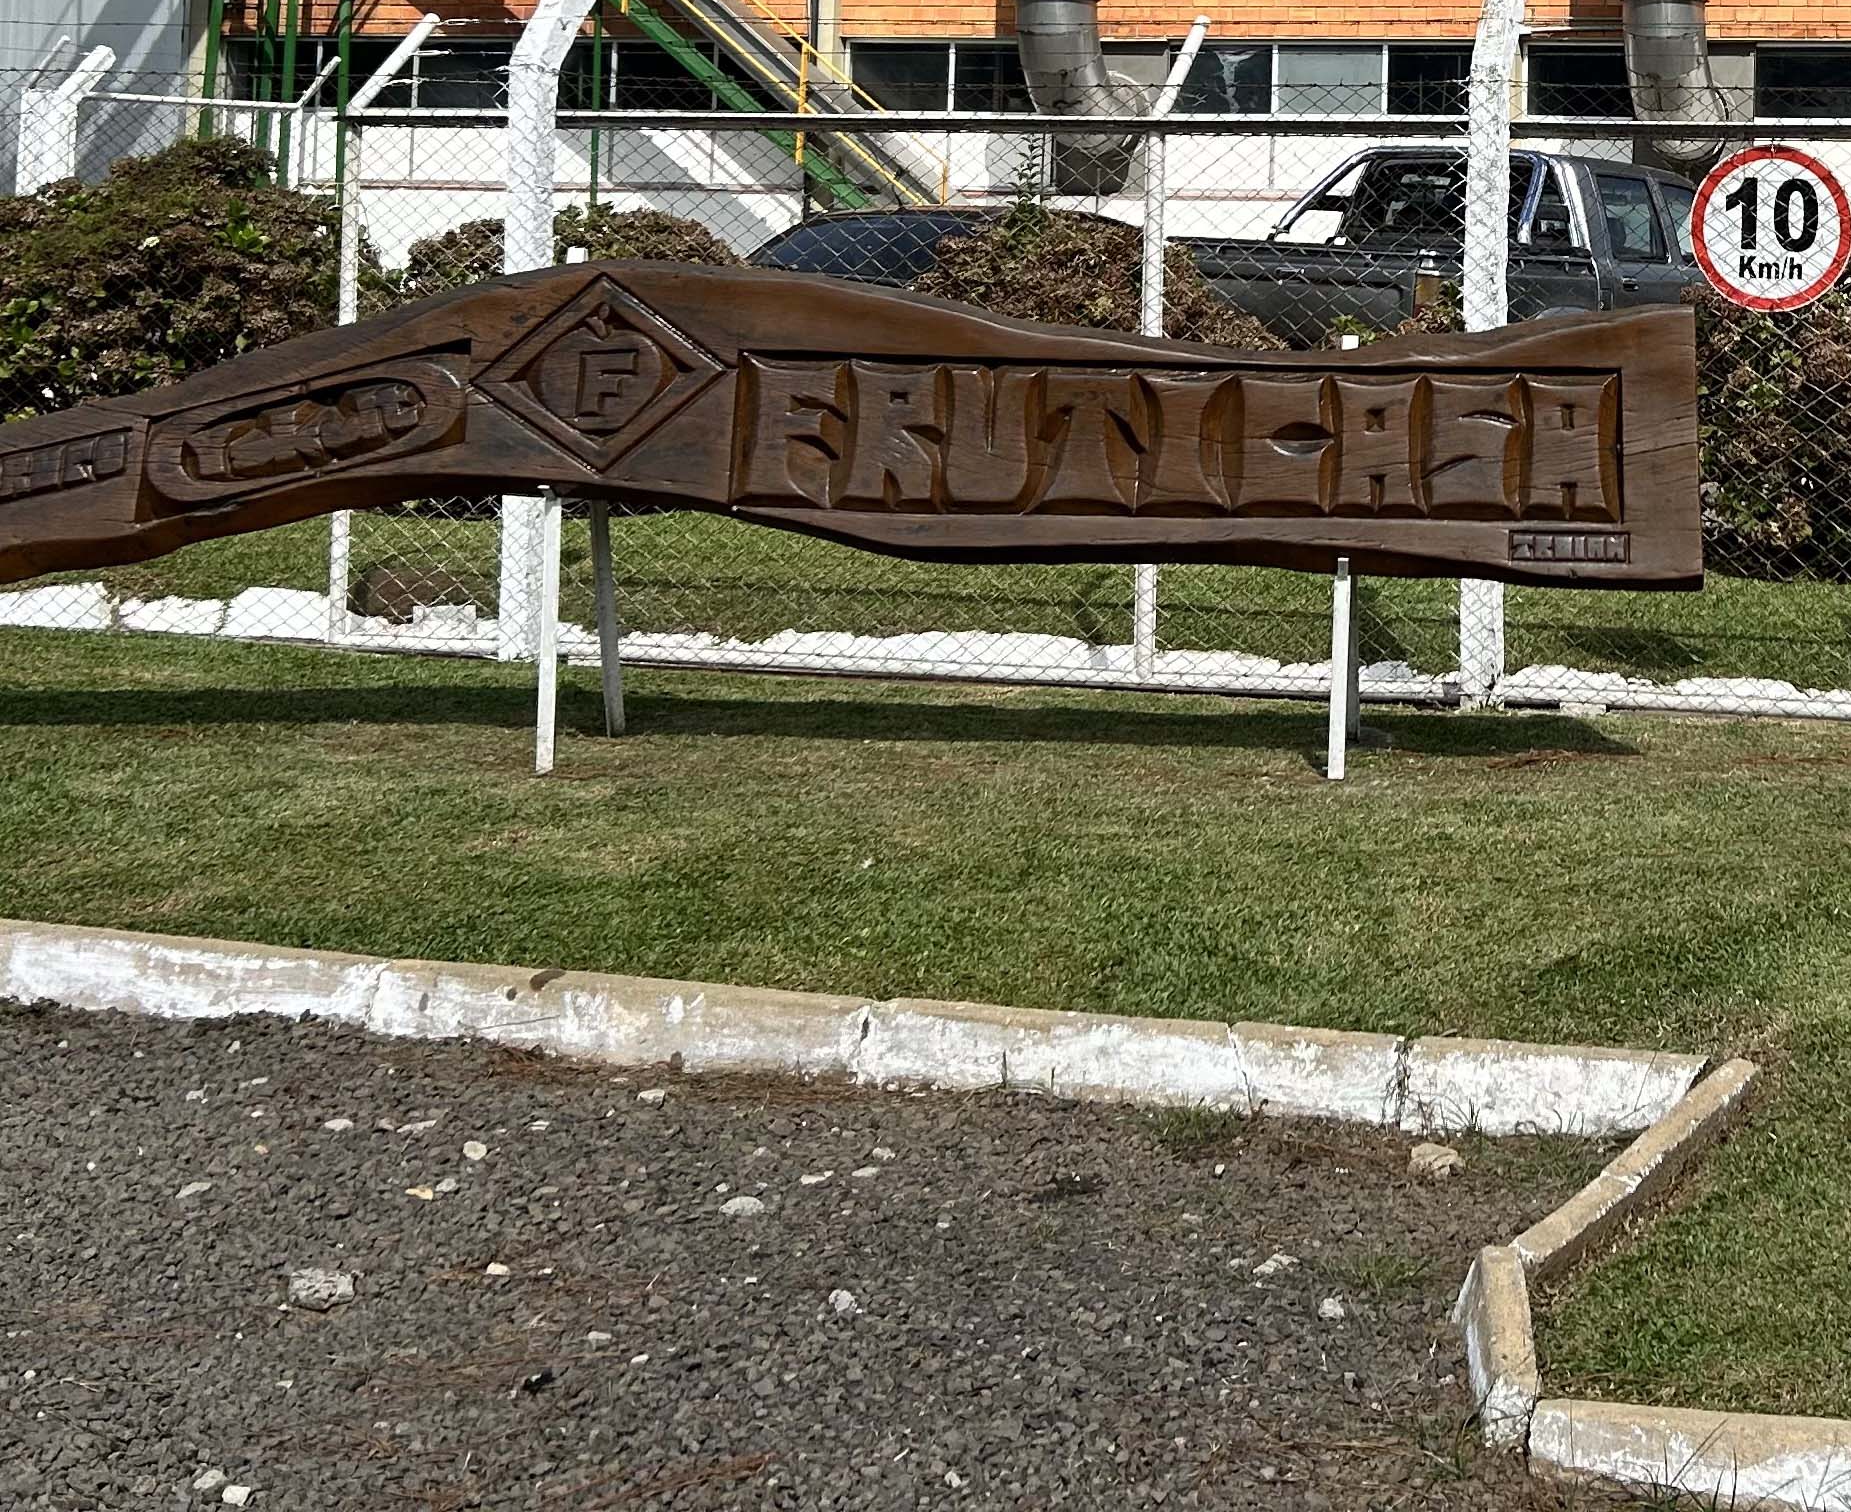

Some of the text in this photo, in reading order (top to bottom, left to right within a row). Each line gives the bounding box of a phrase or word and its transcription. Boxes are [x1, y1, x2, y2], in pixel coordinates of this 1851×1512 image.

[1725, 176, 1819, 253] 10
[1738, 255, 1803, 281] Km/h
[575, 349, 639, 417] F
